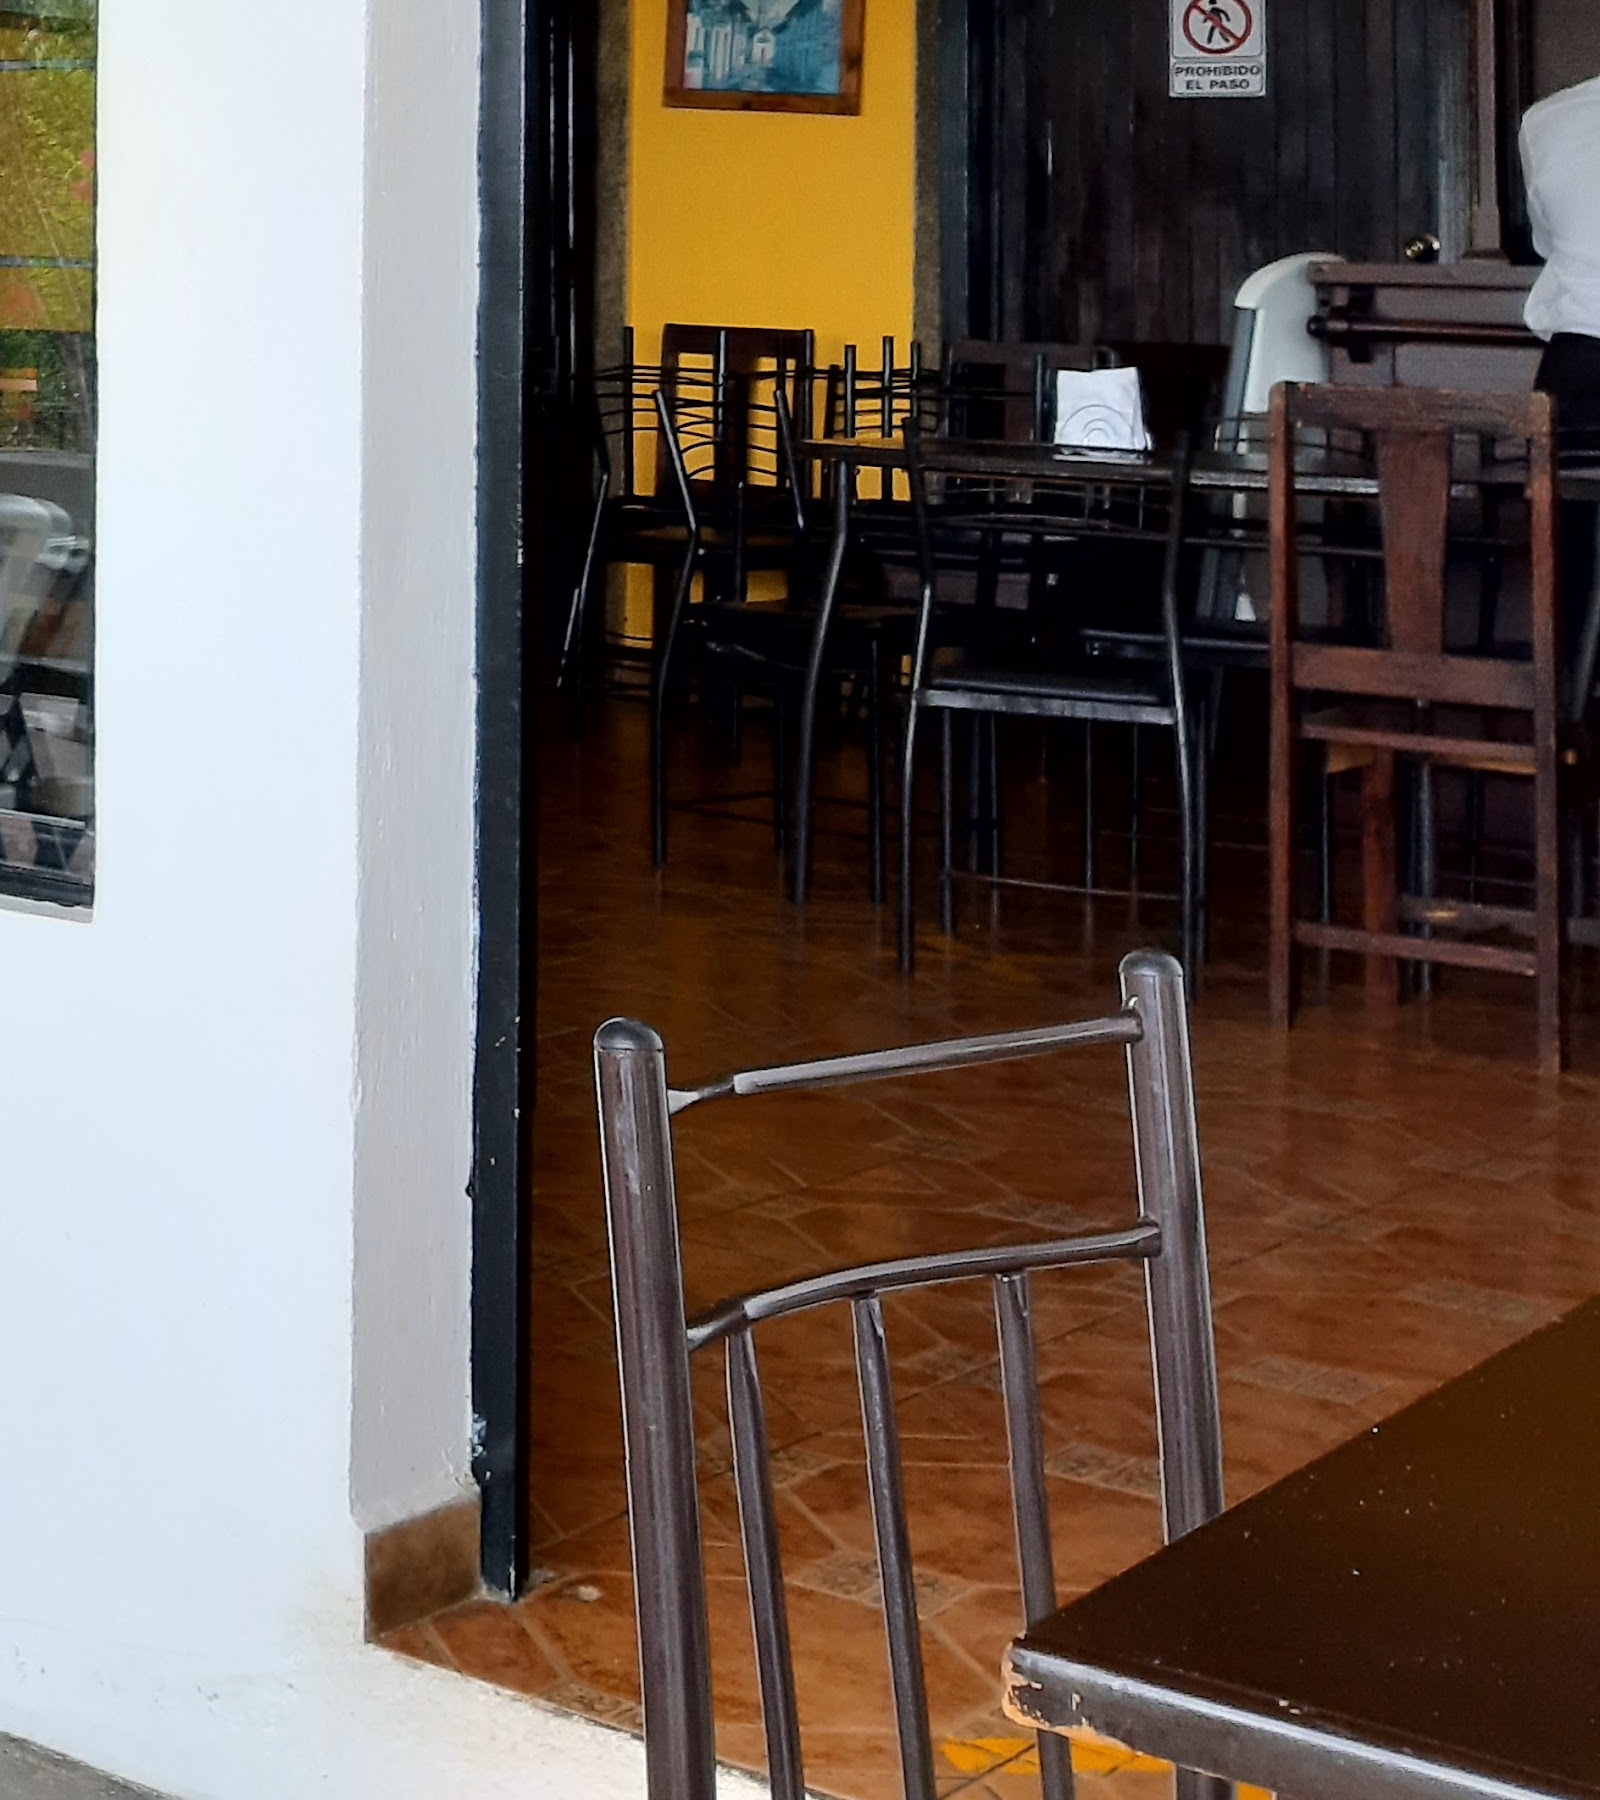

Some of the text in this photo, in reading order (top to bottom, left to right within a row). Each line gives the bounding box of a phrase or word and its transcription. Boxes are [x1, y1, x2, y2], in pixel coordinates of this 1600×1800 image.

[1175, 65, 1260, 77] PROHIBIDO
[1186, 78, 1250, 90] EL PASO
